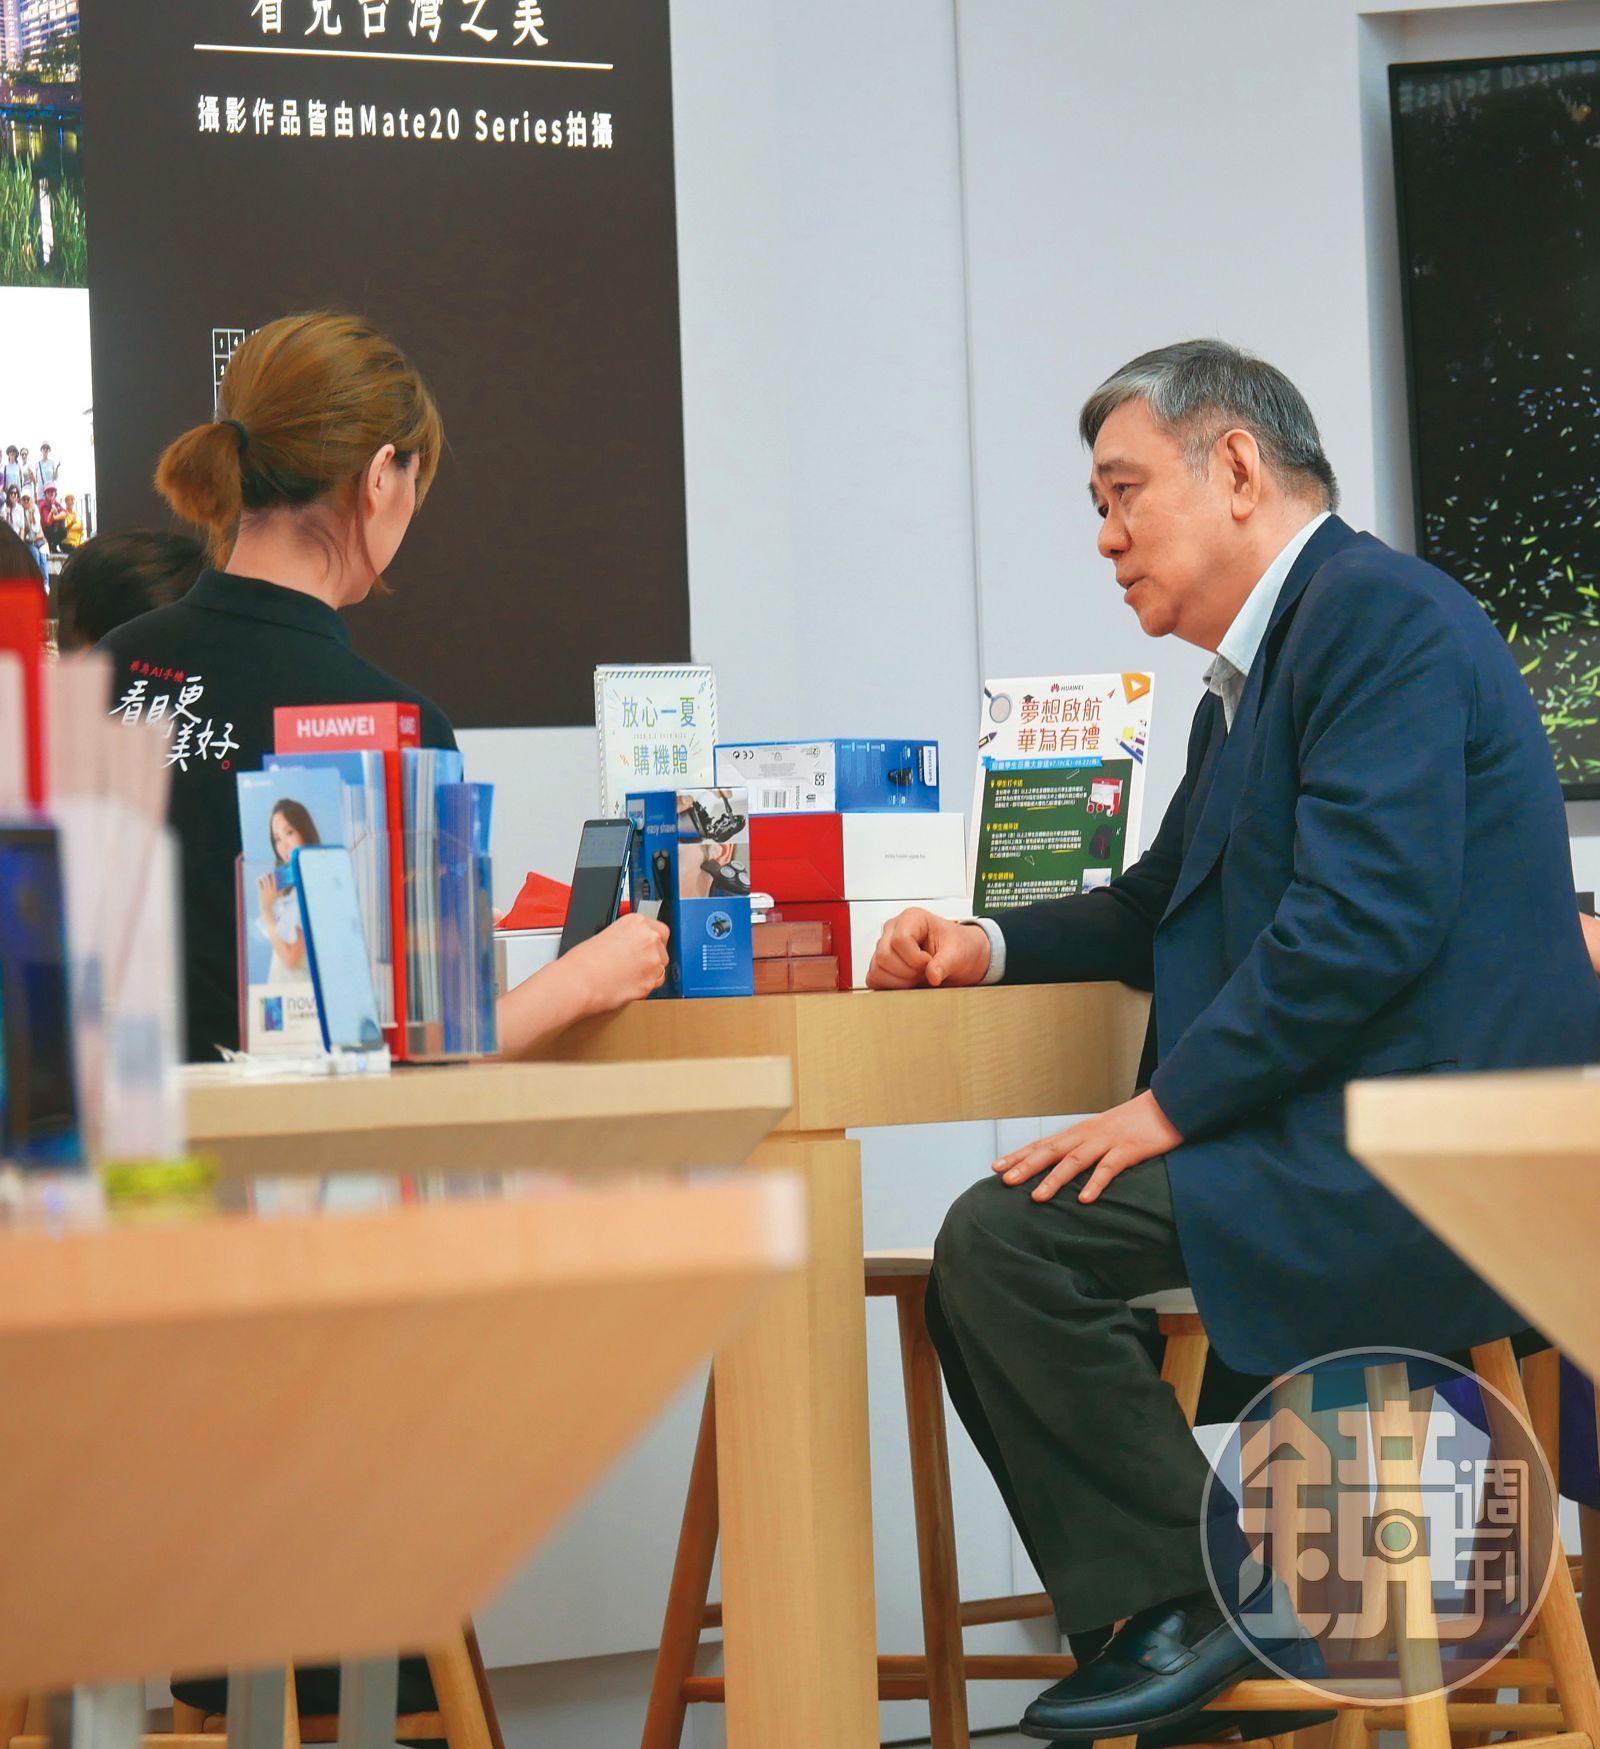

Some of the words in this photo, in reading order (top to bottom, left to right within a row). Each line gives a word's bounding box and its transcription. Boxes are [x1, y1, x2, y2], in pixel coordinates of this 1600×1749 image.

[197, 95, 460, 141] 攝影作品皆由Mate20
[475, 110, 613, 149] Series拍攝
[621, 696, 697, 728] 放心一夏
[1020, 697, 1103, 725] 夢想啟航
[296, 715, 376, 738] HUAWEI
[1017, 724, 1101, 753] 華為有禮
[633, 744, 689, 776] 購機贈
[647, 824, 659, 837] easy
